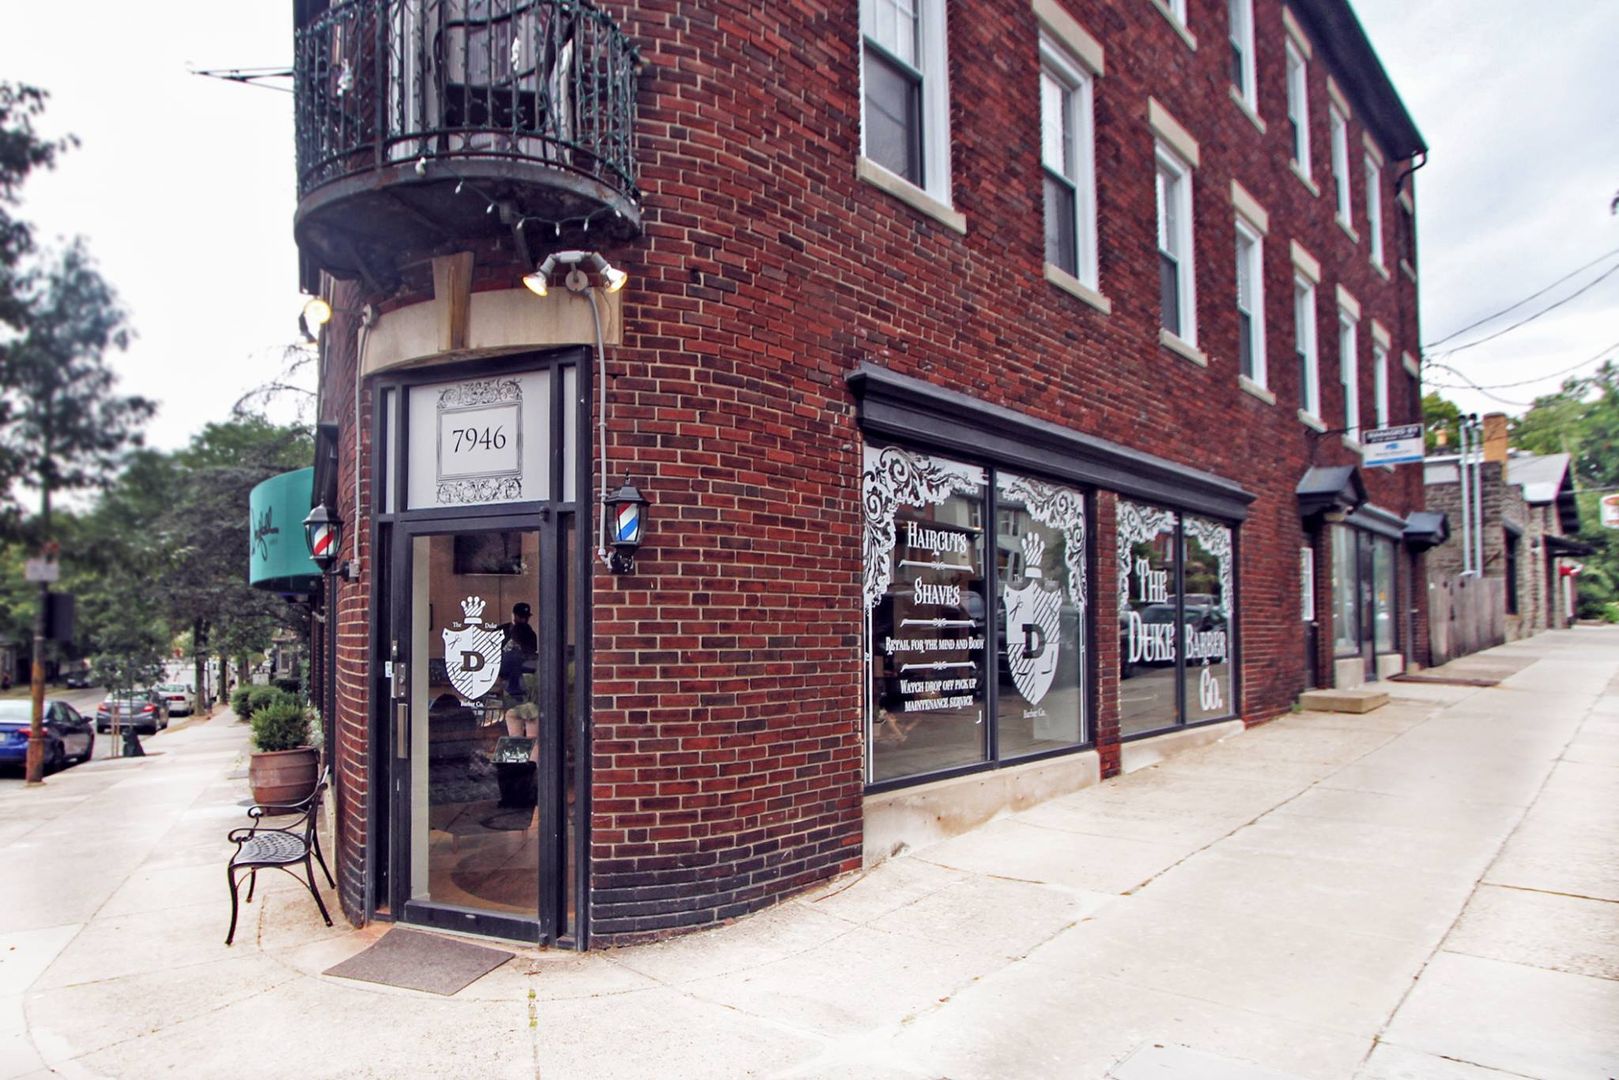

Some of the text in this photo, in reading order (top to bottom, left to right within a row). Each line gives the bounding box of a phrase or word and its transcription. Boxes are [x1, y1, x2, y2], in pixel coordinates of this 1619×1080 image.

[452, 425, 506, 453] 7946
[907, 521, 967, 556] HAIRCUTS
[914, 576, 960, 605] SHAVES
[1135, 555, 1168, 603] THE
[885, 636, 985, 655] RETAIL FOR THE MIND AND BODY
[1022, 624, 1046, 659] D
[1128, 611, 1227, 665] DUKE BARBER
[460, 650, 485, 672] D
[900, 678, 977, 694] WATCH DROP OFF PICK UP
[904, 695, 974, 712] MAINTENANCE SERVICE
